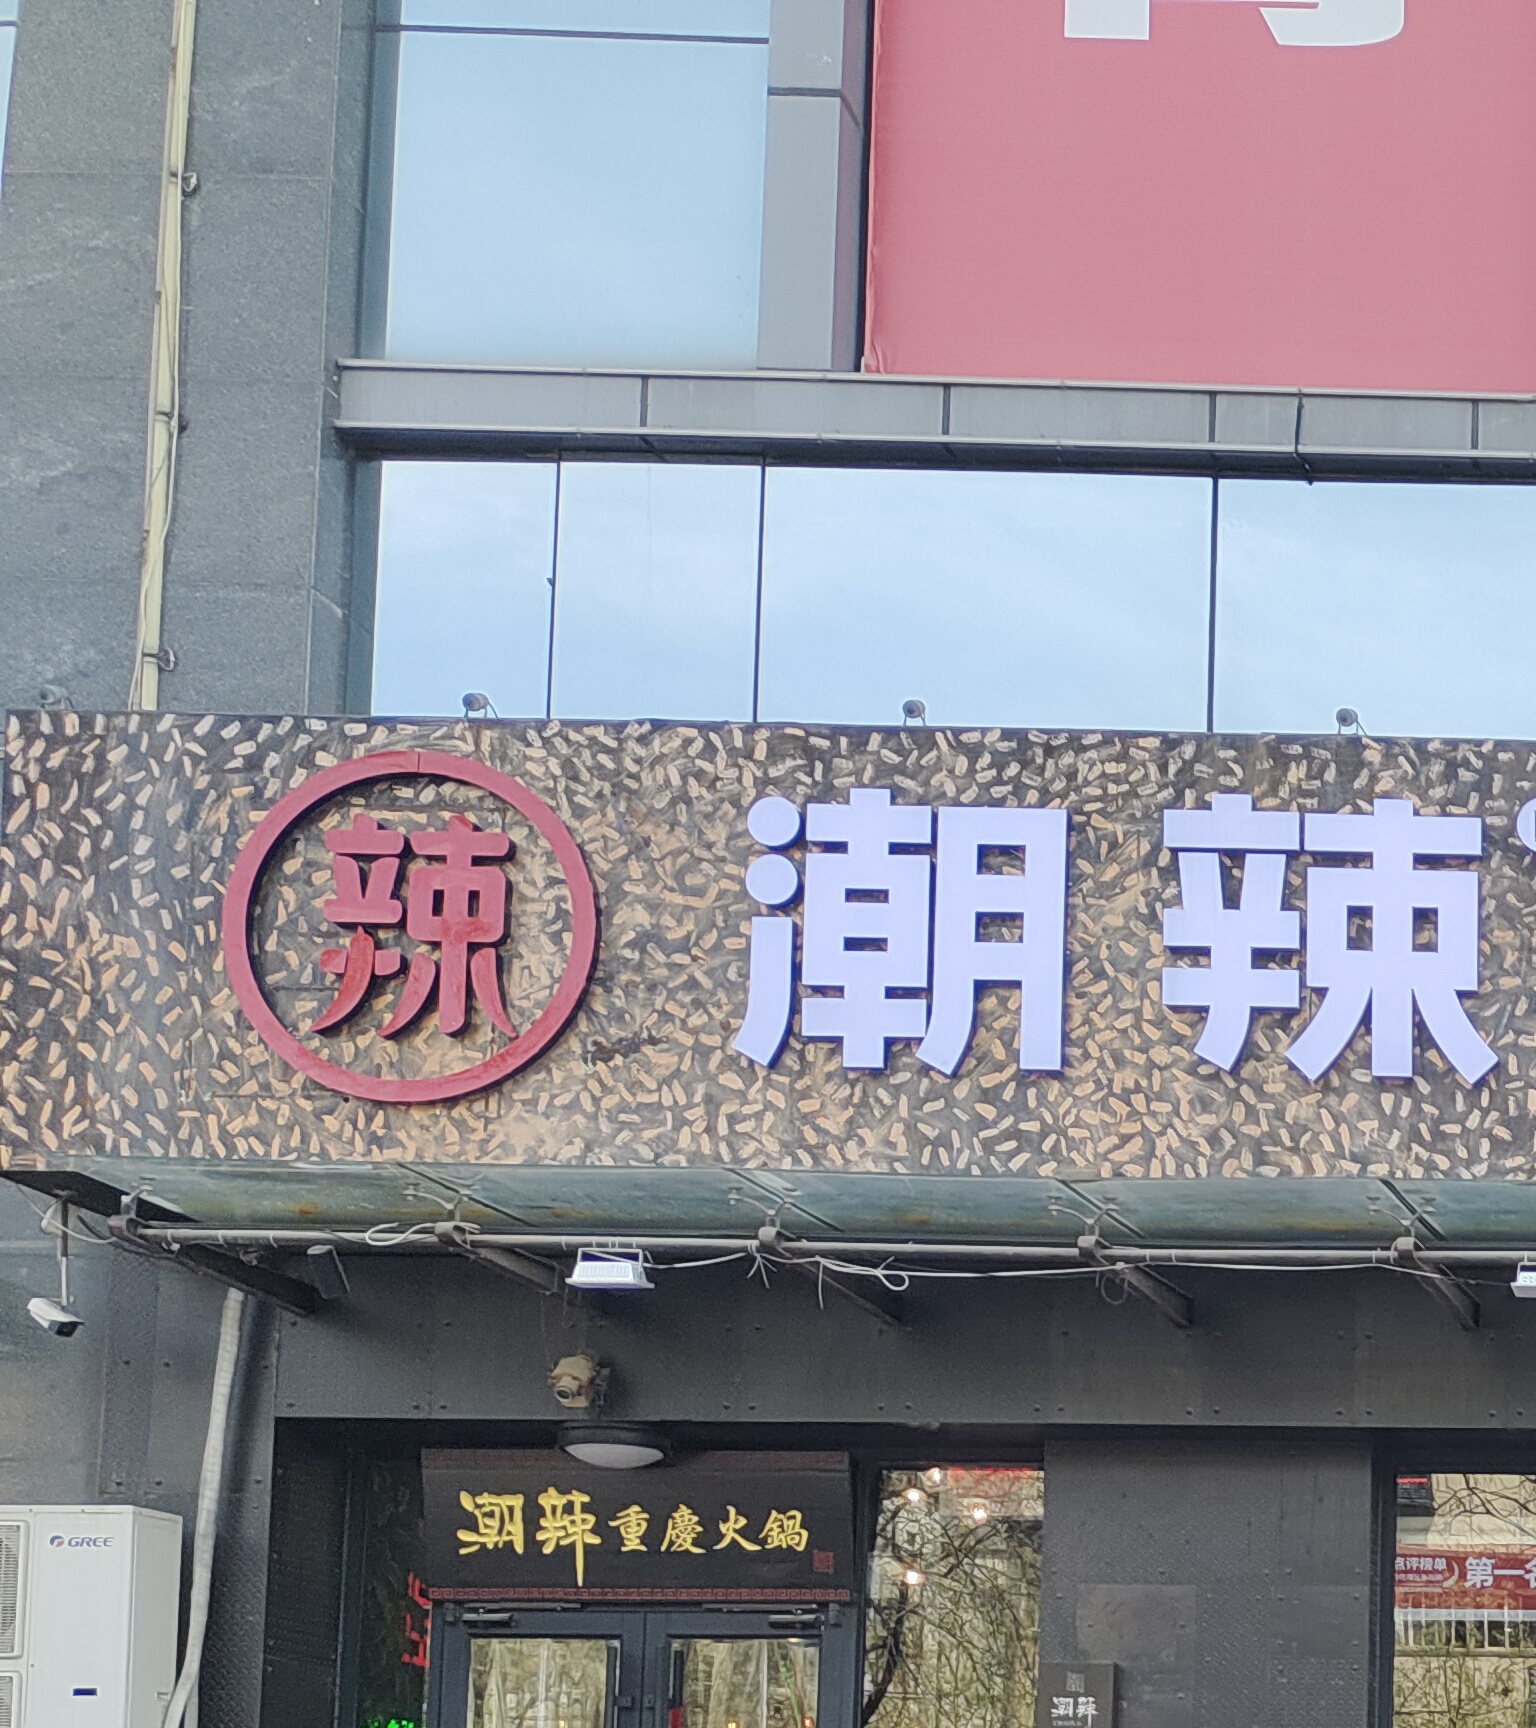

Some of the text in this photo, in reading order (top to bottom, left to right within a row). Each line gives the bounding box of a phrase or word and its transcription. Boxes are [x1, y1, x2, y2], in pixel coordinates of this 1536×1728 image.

[312, 812, 518, 1038] 辣
[734, 788, 1498, 1085] 潮辣
[68, 1536, 114, 1548] GREE
